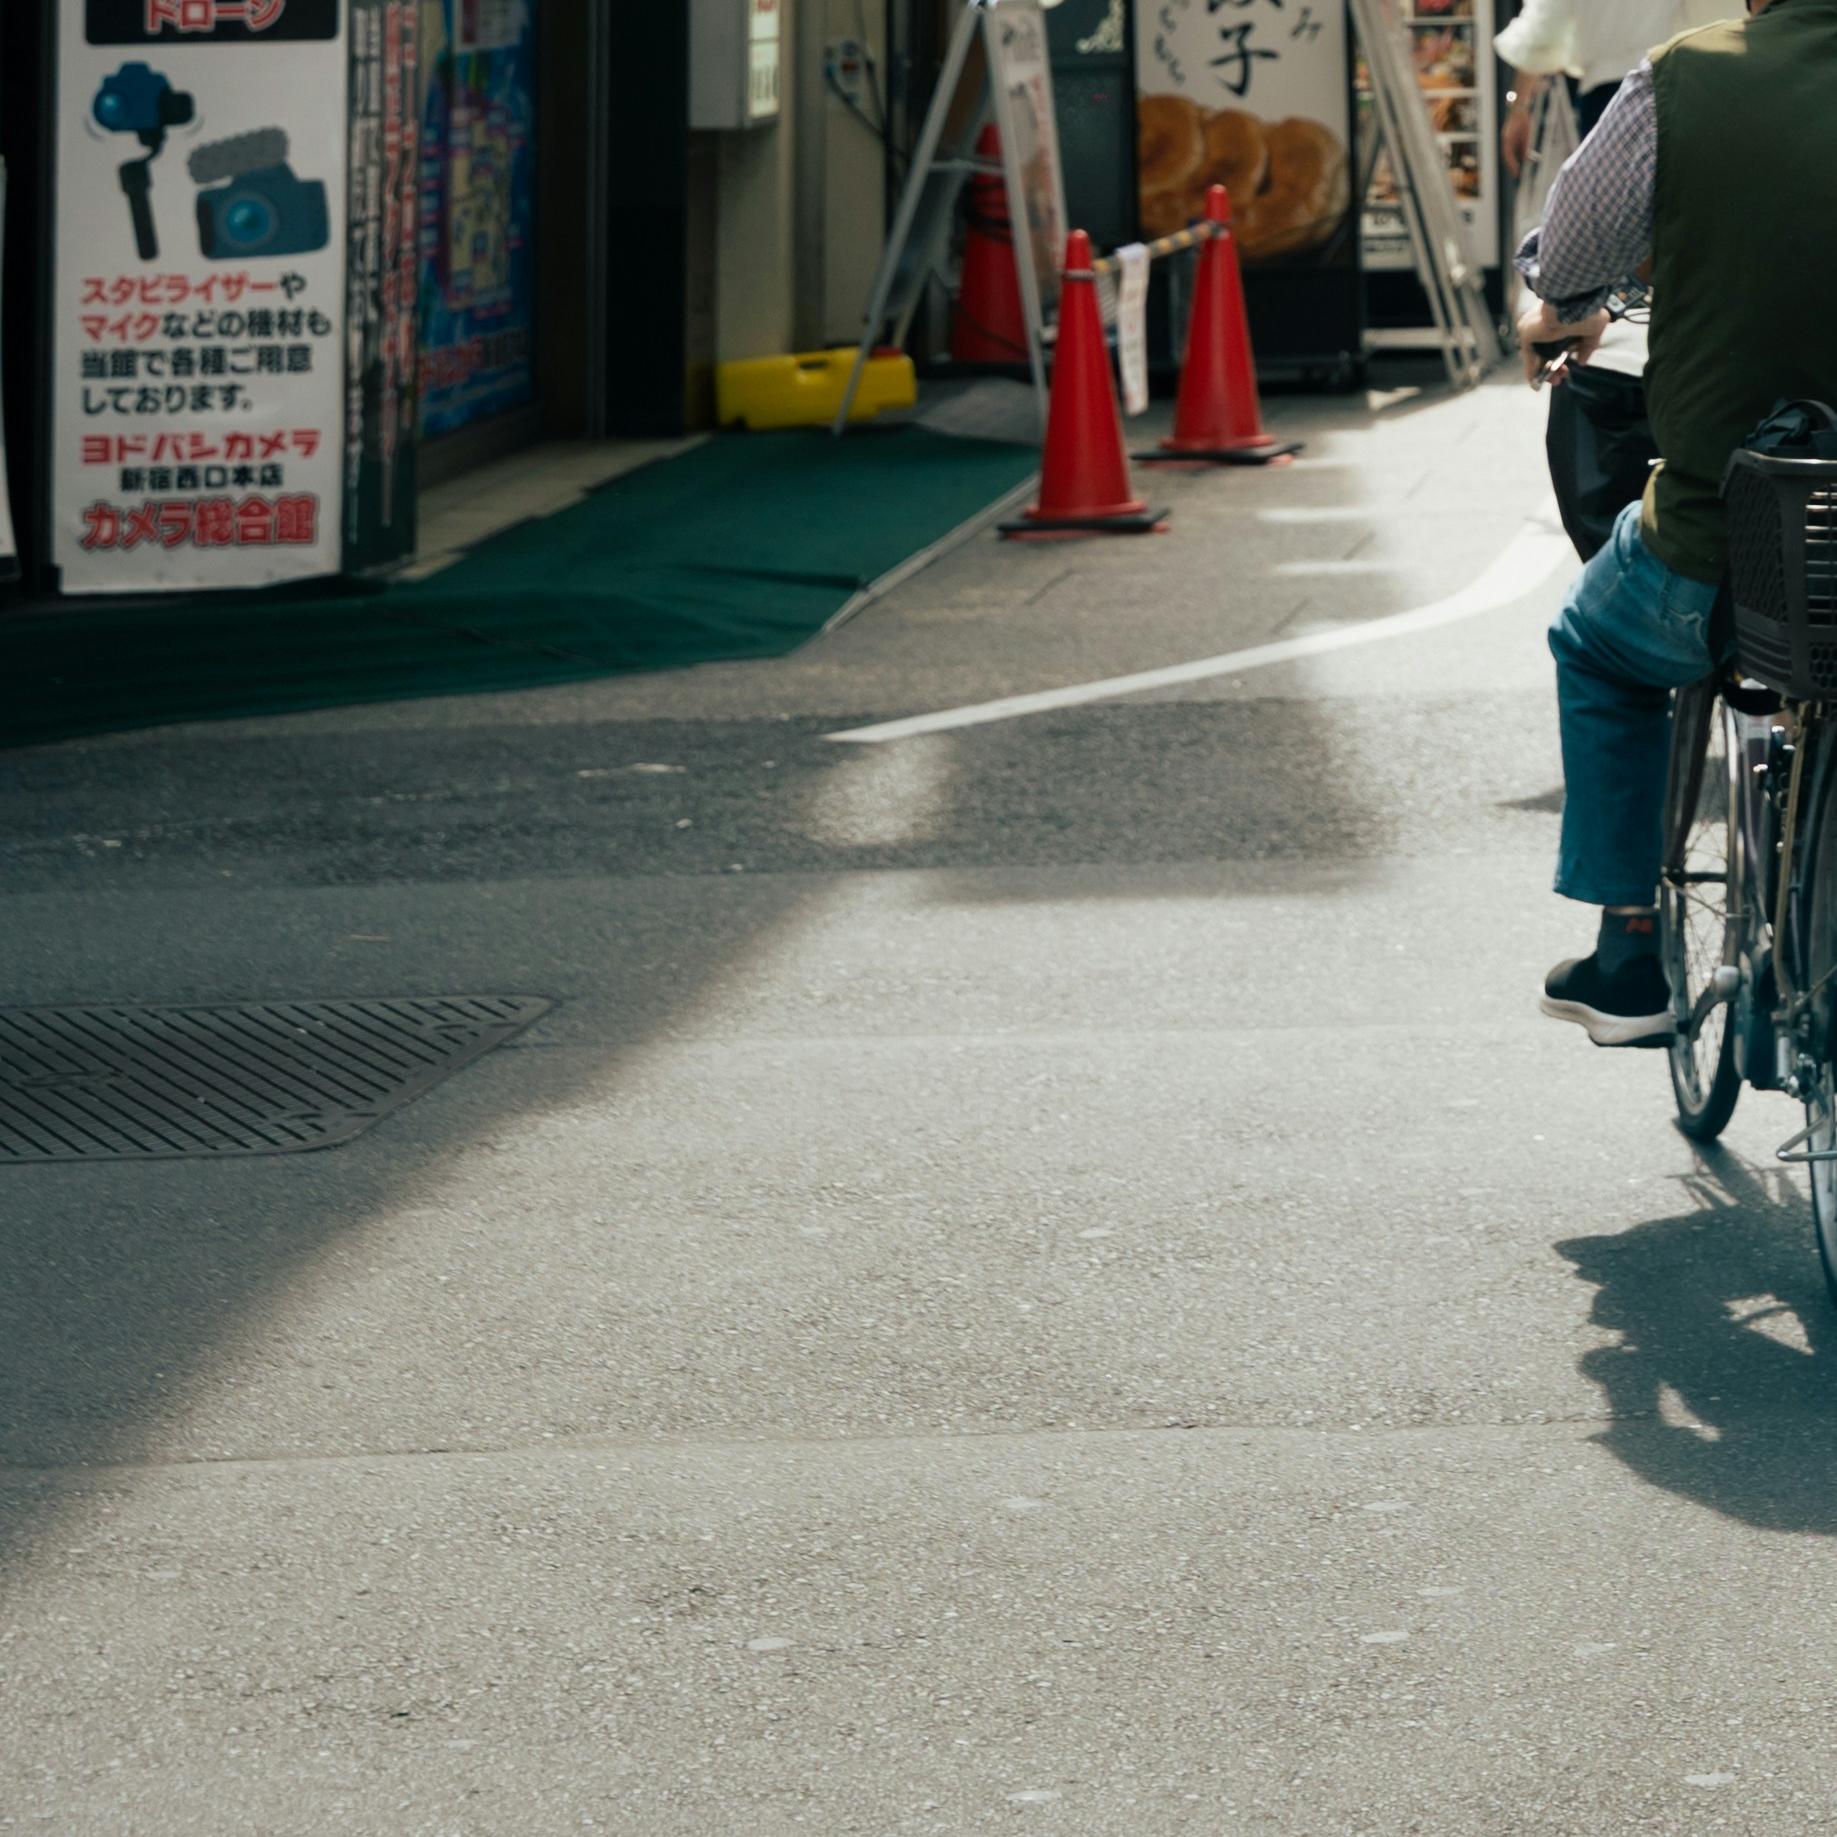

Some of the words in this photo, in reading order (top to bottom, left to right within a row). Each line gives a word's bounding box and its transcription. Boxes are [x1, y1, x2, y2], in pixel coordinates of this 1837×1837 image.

[81, 270, 308, 306] スタビライザーや
[80, 309, 333, 343] マイクなどの機材も
[80, 344, 314, 380] 当館で各種ご用意
[81, 381, 255, 416] しております。
[81, 427, 321, 465] ヨドバシカメラ
[119, 461, 285, 492] 新宿西口本店
[78, 492, 319, 549] カメラ総合館
